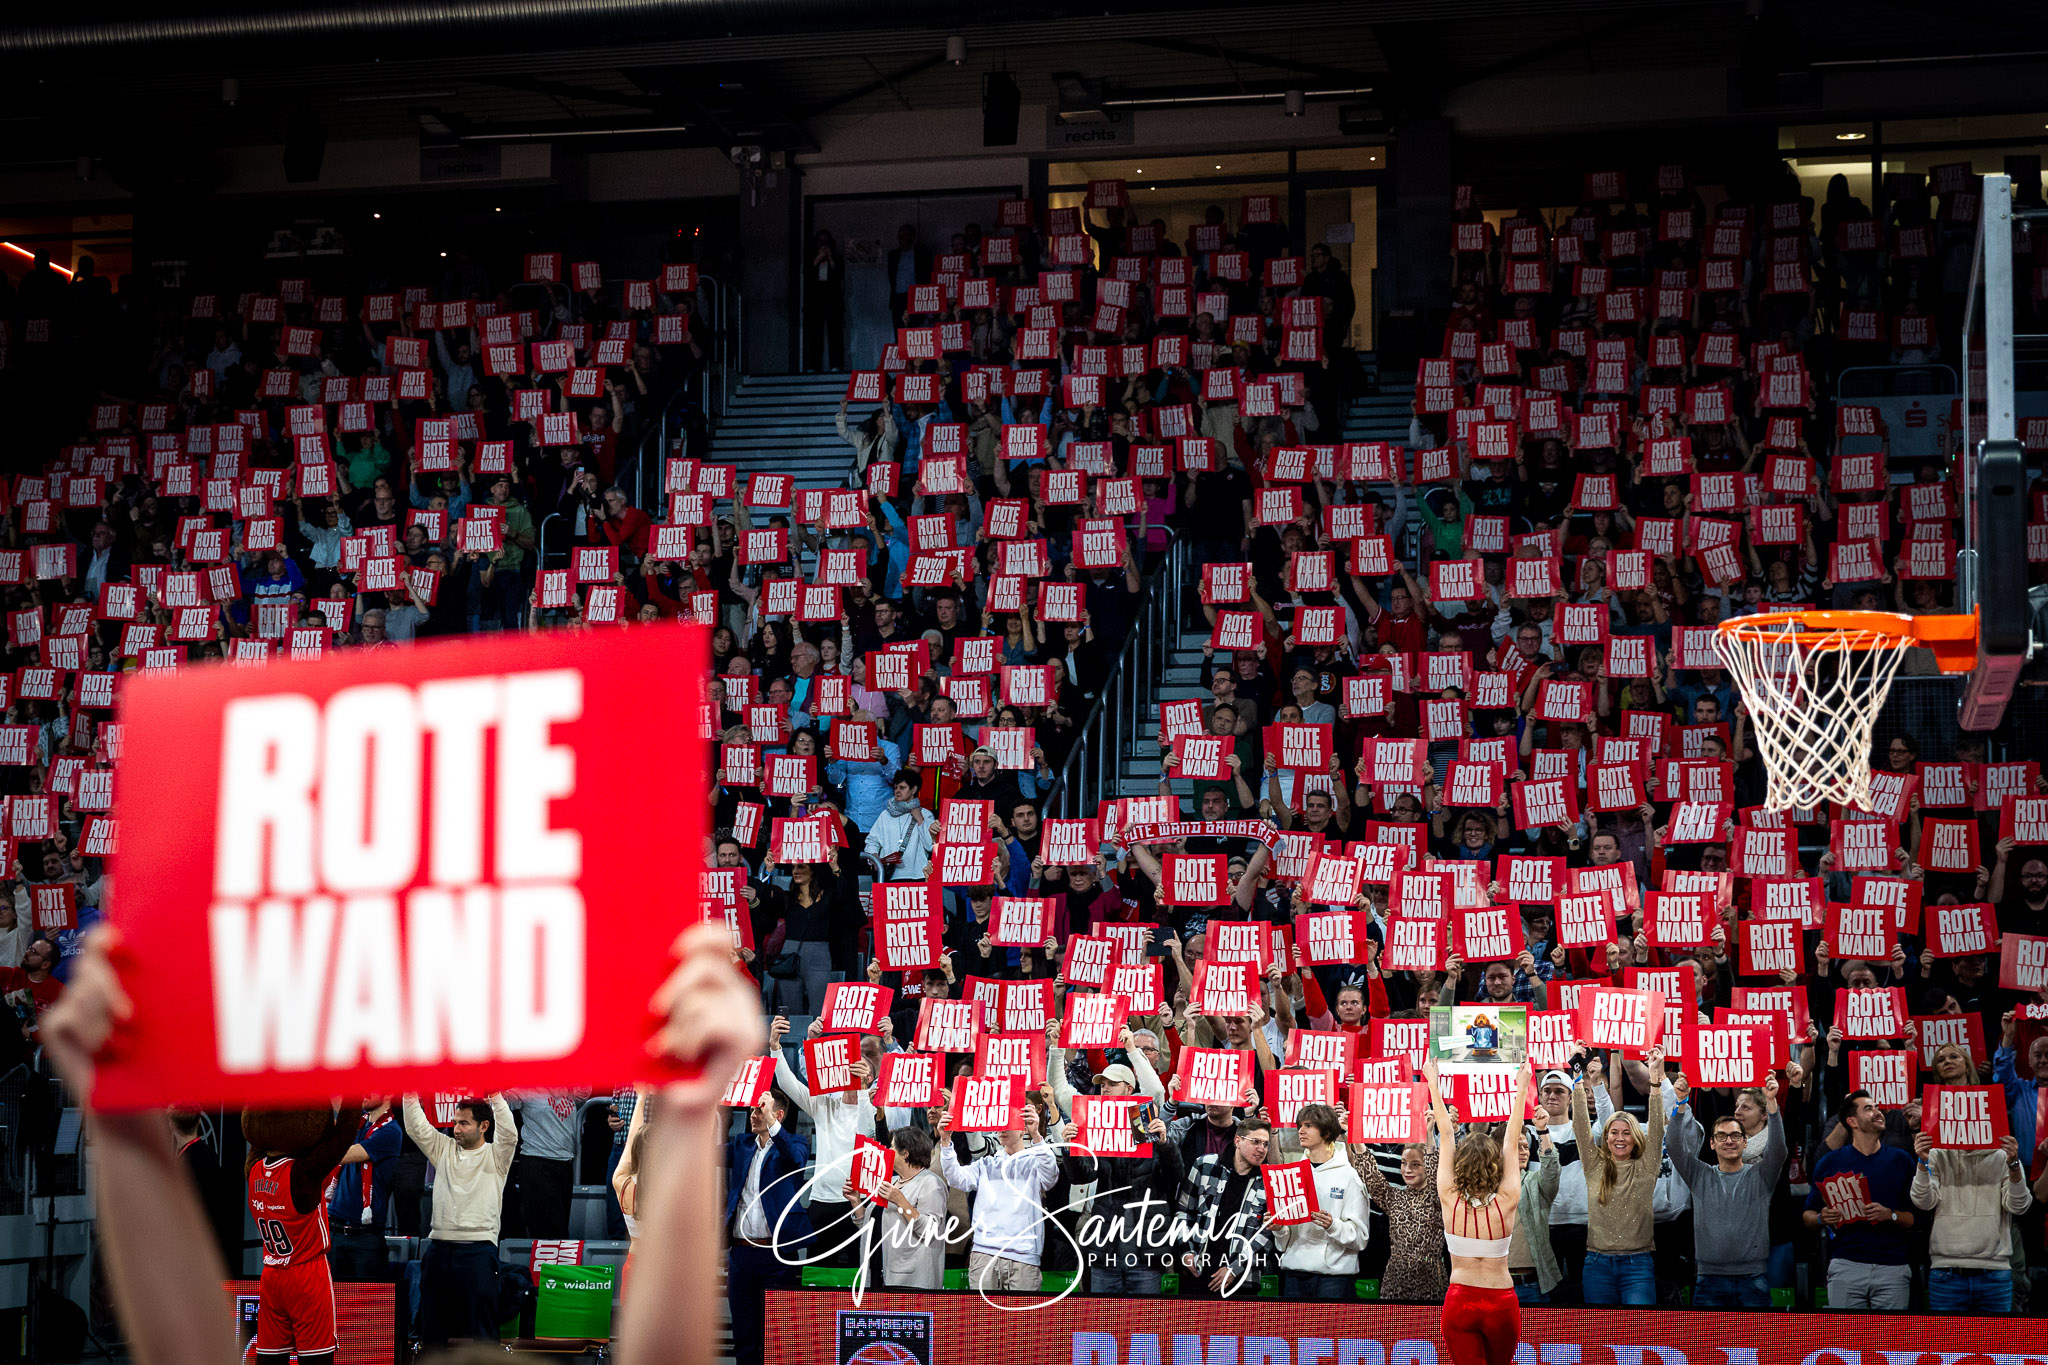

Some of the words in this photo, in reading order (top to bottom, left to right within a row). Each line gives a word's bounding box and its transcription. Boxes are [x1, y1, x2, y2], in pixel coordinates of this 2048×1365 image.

[1272, 259, 1296, 273] ROTE
[1271, 272, 1296, 285] WAND
[906, 330, 933, 345] ROTE
[907, 345, 933, 357] WAND
[1072, 376, 1098, 391] ROTE
[1071, 391, 1098, 404] WAND
[544, 415, 569, 431] ROTE
[1477, 425, 1507, 441] ROTE
[1580, 415, 1608, 433] ROTE
[544, 430, 569, 443] WAND
[1008, 427, 1037, 443] ROTE
[1580, 432, 1609, 447] WAND
[423, 442, 449, 457] ROTE
[1007, 443, 1037, 456] WAND
[1477, 442, 1508, 456] WAND
[422, 456, 449, 469] WAND
[1774, 458, 1807, 477] ROTE
[1841, 456, 1874, 475] ROTE
[1049, 472, 1078, 489] ROTE
[1772, 475, 1806, 492] WAND
[1841, 473, 1873, 490] WAND
[674, 495, 703, 511] ROTE
[1048, 488, 1078, 502] WAND
[674, 511, 703, 524] WAND
[1762, 508, 1795, 526] ROTE
[748, 531, 778, 548] ROTE
[1762, 526, 1795, 542] WAND
[579, 550, 609, 566] ROTE
[747, 547, 777, 561] WAND
[367, 558, 395, 575] ROTE
[578, 566, 608, 580] WAND
[1212, 567, 1242, 585] ROTE
[1439, 563, 1473, 582] ROTE
[1516, 560, 1549, 579] ROTE
[366, 574, 395, 589] WAND
[1439, 581, 1473, 598] WAND
[1516, 579, 1549, 595] WAND
[1046, 585, 1078, 604] ROTE
[1211, 585, 1241, 600] WAND
[180, 608, 211, 624] ROTE
[1044, 604, 1076, 619] WAND
[1302, 609, 1335, 627] ROTE
[1564, 607, 1598, 626] ROTE
[177, 625, 208, 638] WAND
[1300, 627, 1333, 642] WAND
[1563, 626, 1597, 641] WAND
[1610, 639, 1645, 658] ROTE
[1610, 659, 1645, 675] WAND
[1010, 669, 1045, 687] ROTE
[1349, 678, 1382, 698] ROTE
[1010, 688, 1044, 703] WAND
[1349, 697, 1382, 714] WAND
[839, 723, 868, 744] ROTE
[1283, 727, 1320, 749] ROTE
[726, 747, 754, 767] ROTE
[839, 742, 868, 759] WAND
[1183, 739, 1221, 760] ROTE
[1282, 748, 1320, 767] WAND
[1375, 742, 1415, 763] ROTE
[726, 766, 754, 783] WAND
[773, 758, 807, 778] ROTE
[1180, 759, 1218, 777] WAND
[1373, 763, 1413, 781] WAND
[1453, 765, 1492, 786] ROTE
[1597, 766, 1632, 790] ROTE
[1923, 766, 1963, 787] ROTE
[215, 669, 582, 899] ROTE
[772, 777, 806, 794] WAND
[1451, 786, 1490, 804] WAND
[1599, 787, 1634, 809] WAND
[1924, 787, 1964, 804] WAND
[1050, 823, 1087, 844] ROTE
[1844, 824, 1886, 847] ROTE
[1932, 823, 1969, 849] ROTE
[1049, 844, 1085, 862] WAND
[1843, 847, 1887, 867] WAND
[1931, 847, 1967, 869] WAND
[1174, 859, 1216, 882] ROTE
[1510, 860, 1553, 882] ROTE
[1174, 882, 1216, 902] WAND
[1508, 882, 1552, 901] WAND
[1001, 901, 1044, 924] ROTE
[1560, 896, 1604, 923] ROTE
[1657, 896, 1702, 921] ROTE
[1309, 915, 1353, 940] ROTE
[1464, 910, 1508, 937] ROTE
[1839, 908, 1885, 935] ROTE
[1938, 908, 1983, 934] ROTE
[885, 921, 928, 947] ROTE
[998, 924, 1041, 943] WAND
[1393, 921, 1437, 946] ROTE
[1562, 920, 1606, 944] WAND
[1656, 922, 1702, 943] WAND
[1750, 923, 1793, 949] ROTE
[1940, 931, 1985, 953] WAND
[1309, 939, 1354, 961] WAND
[1465, 935, 1510, 958] WAND
[1838, 934, 1884, 957] WAND
[887, 945, 930, 967] WAND
[1392, 945, 1435, 967] WAND
[1751, 949, 1795, 971] WAND
[209, 884, 586, 1075] WAND
[1205, 966, 1247, 991] ROTE
[833, 986, 878, 1010] ROTE
[1006, 984, 1044, 1009] ROTE
[1204, 991, 1246, 1012] WAND
[1847, 992, 1893, 1016] ROTE
[1072, 998, 1116, 1023] ROTE
[1593, 992, 1648, 1023] ROTE
[829, 1008, 873, 1029] WAND
[1005, 1009, 1043, 1031] WAND
[1847, 1016, 1893, 1036] WAND
[1069, 1023, 1113, 1044] WAND
[1590, 1020, 1645, 1046] WAND
[1699, 1030, 1752, 1058] ROTE
[890, 1058, 933, 1082] ROTE
[1192, 1052, 1240, 1080] ROTE
[1699, 1059, 1753, 1083] WAND
[887, 1083, 930, 1103] WAND
[963, 1080, 1012, 1106] ROTE
[1189, 1077, 1237, 1102] WAND
[1363, 1088, 1412, 1115] ROTE
[1939, 1091, 1990, 1120] ROTE
[961, 1106, 1009, 1127] WAND
[1361, 1116, 1411, 1138] WAND
[1939, 1121, 1991, 1145] WAND
[258, 1217, 293, 1256] 99
[564, 1279, 612, 1290] wieland
[845, 1317, 924, 1330] BAMBERG
